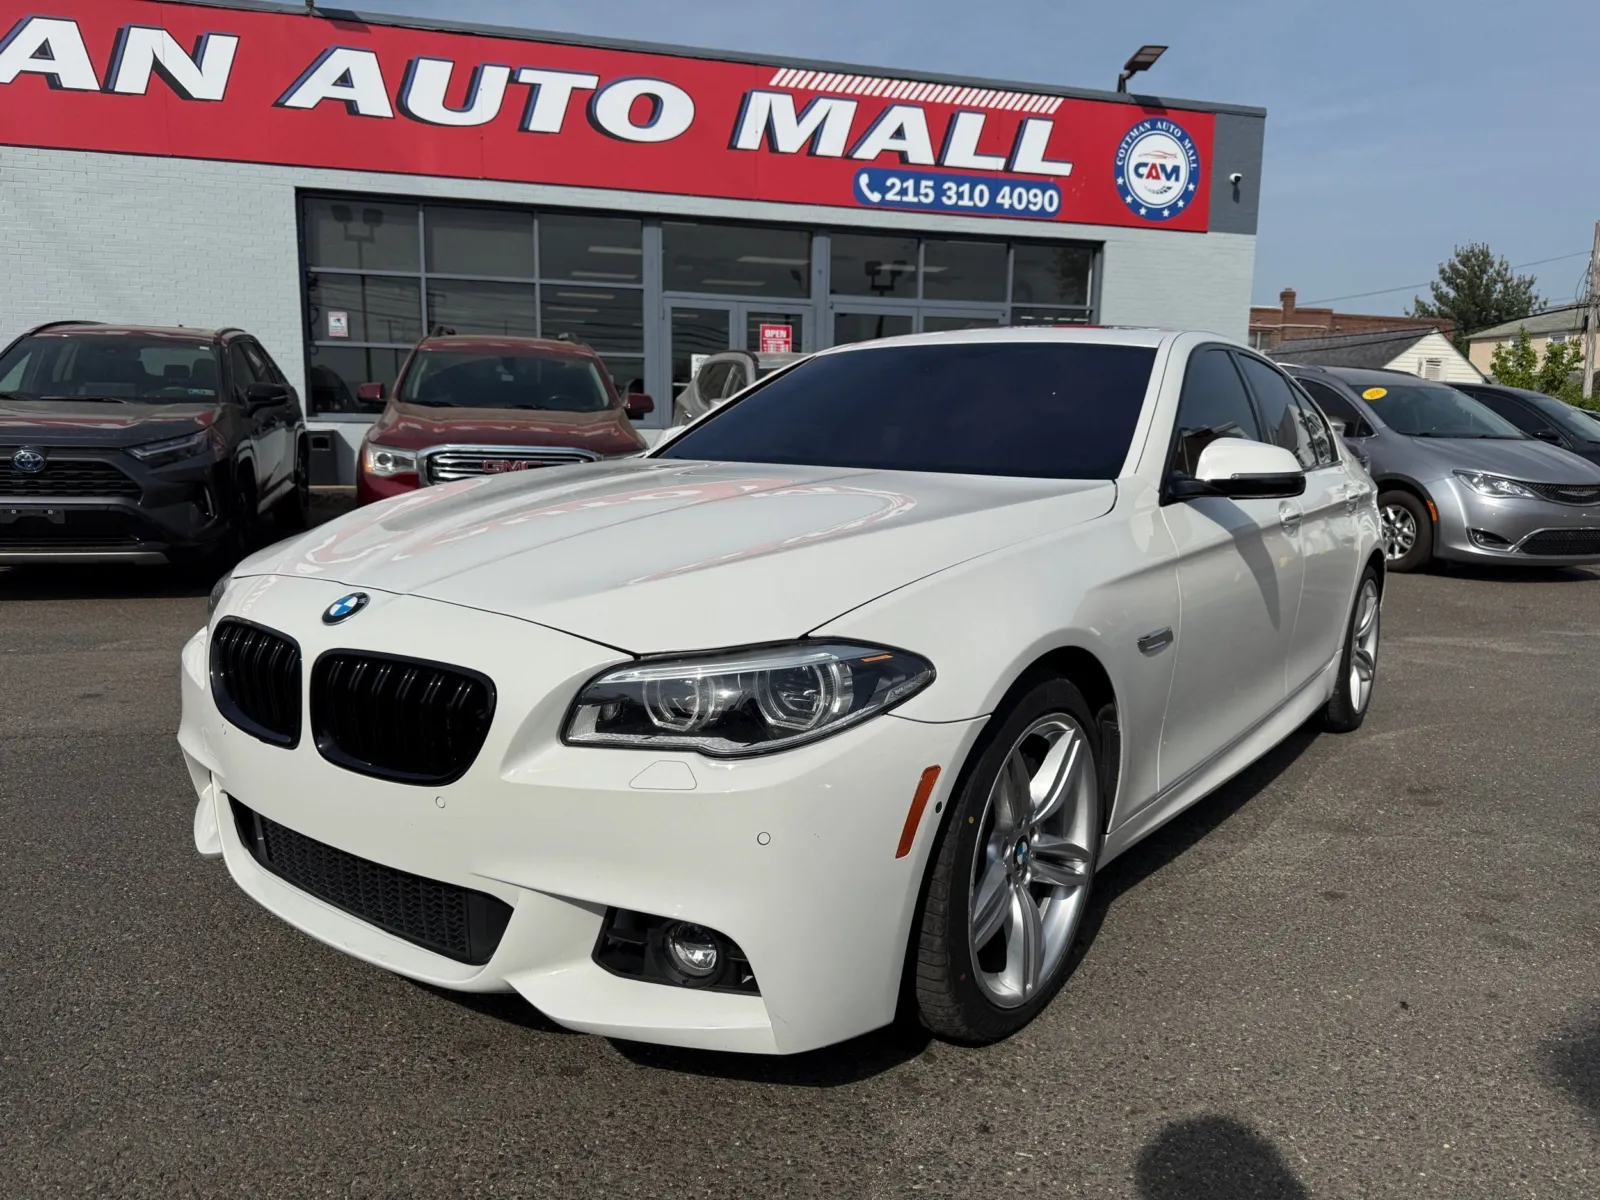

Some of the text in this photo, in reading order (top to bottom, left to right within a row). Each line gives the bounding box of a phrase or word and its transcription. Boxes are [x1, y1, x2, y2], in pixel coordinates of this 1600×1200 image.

[0, 15, 1074, 177] AN AUTO MALL
[1115, 121, 1198, 171] COTTMAN AUTO MALL
[1133, 161, 1181, 183] CAM
[884, 176, 1060, 213] 215 310 4090
[764, 328, 788, 338] OPEN
